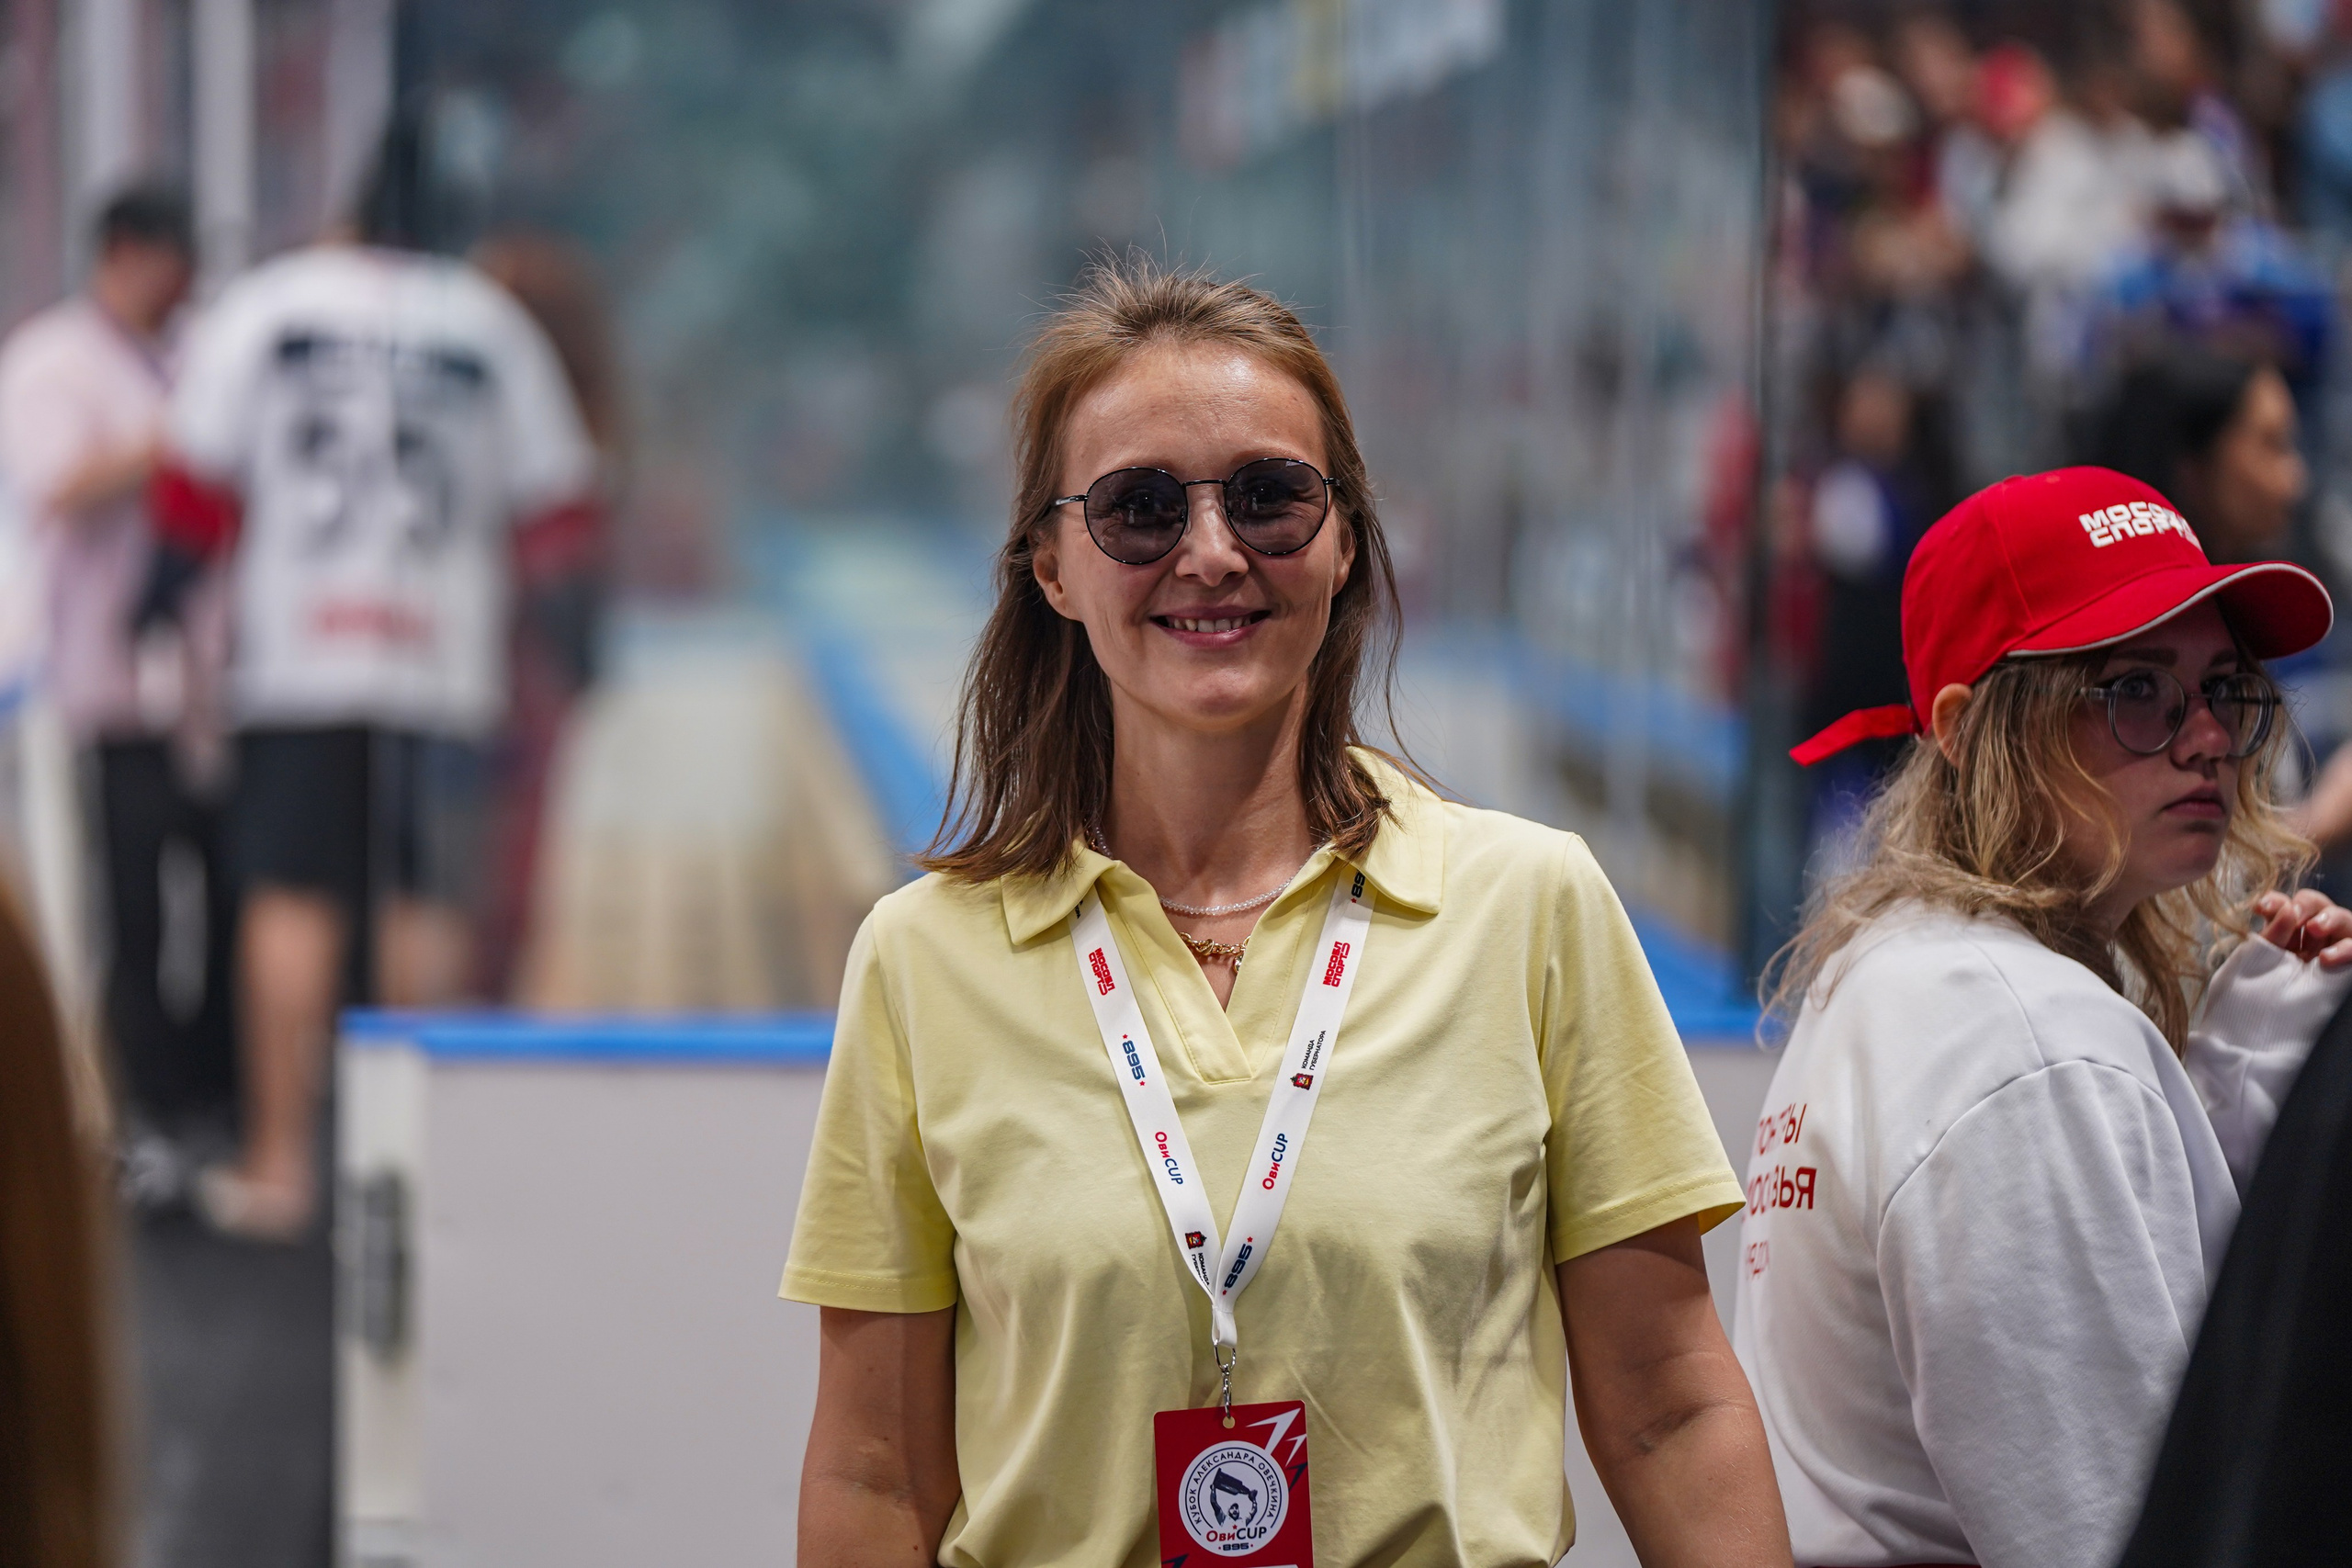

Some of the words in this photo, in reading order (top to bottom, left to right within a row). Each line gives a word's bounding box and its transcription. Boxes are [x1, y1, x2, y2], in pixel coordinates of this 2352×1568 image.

[1351, 869, 1366, 898] 89
[1094, 947, 1115, 991] МОСОБЛ
[1323, 941, 1342, 986] МОСОБЛ
[1123, 1040, 1146, 1080] 895
[1301, 1039, 1315, 1069] КОМАНДА
[1309, 1030, 1326, 1071] ГУБЕРНАТОРА
[1198, 1252, 1210, 1285] КОМАНДА
[1224, 1243, 1252, 1289] 895
[1193, 1451, 1255, 1484] АЛЕКСАНДРА
[1189, 1488, 1202, 1525] КУБОК
[1258, 1462, 1278, 1518] ОВЕЧКИНА
[1223, 1542, 1250, 1551] 895
